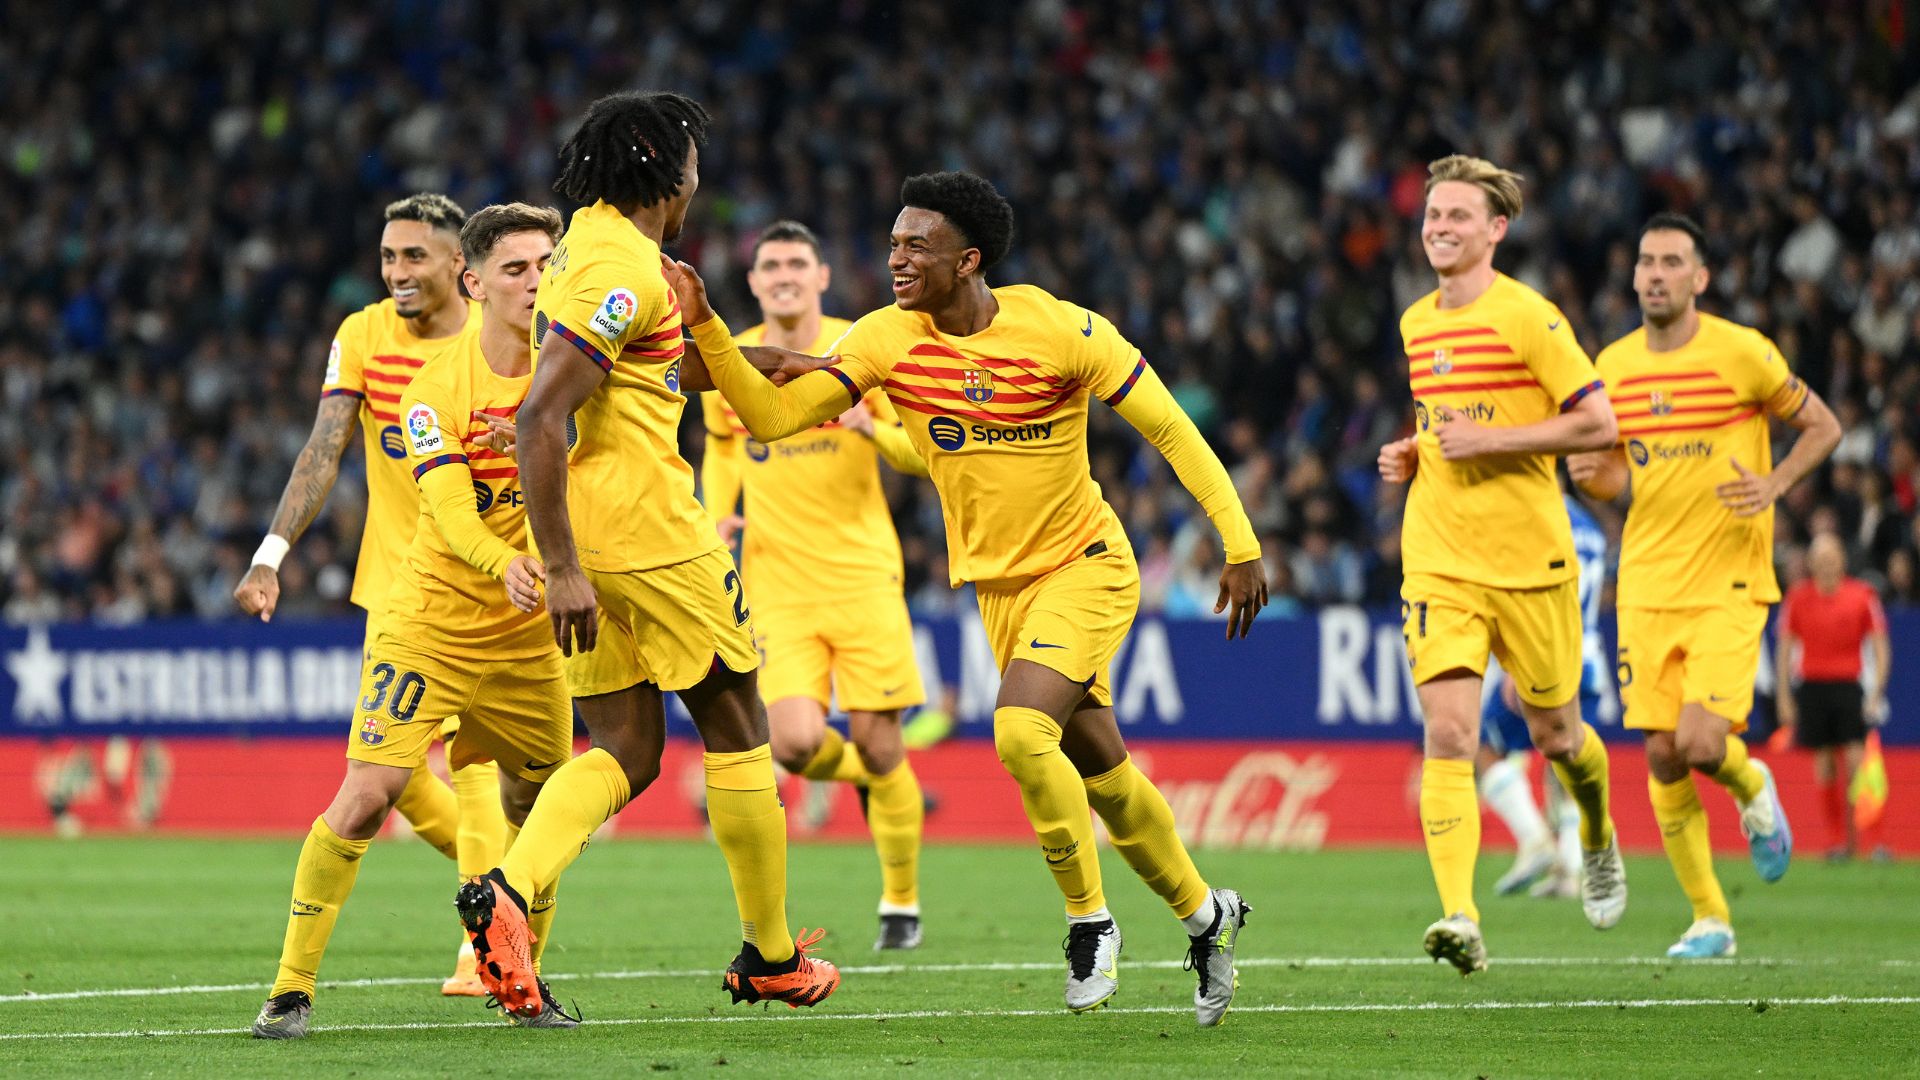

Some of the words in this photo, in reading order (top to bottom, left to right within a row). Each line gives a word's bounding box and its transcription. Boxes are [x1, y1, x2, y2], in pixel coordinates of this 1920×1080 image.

[595, 314, 620, 335] LaLiga
[1433, 402, 1495, 423] Stify
[971, 421, 1052, 445] Spotify
[1652, 440, 1712, 460] Spotify
[723, 569, 750, 628] 2
[72, 648, 288, 722] ESTRELLA
[361, 661, 427, 722] 30
[1042, 840, 1079, 854] barça
[293, 897, 323, 914] barça
